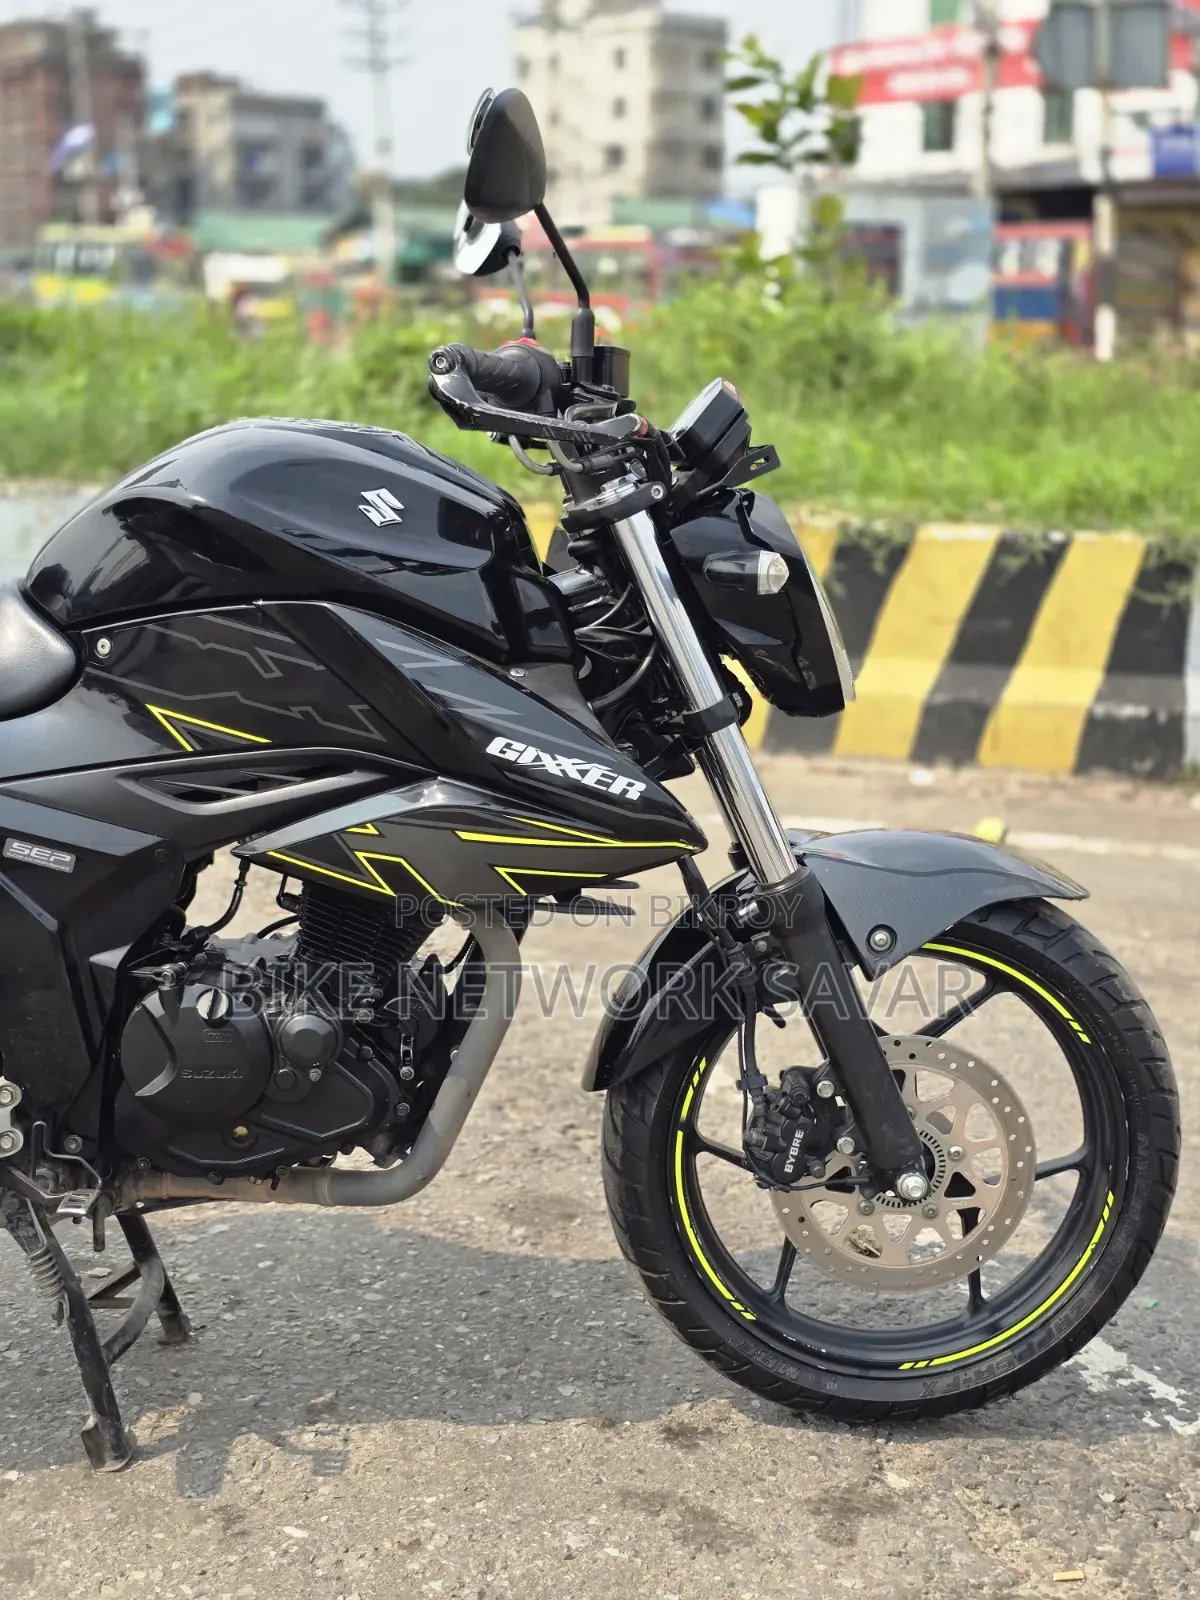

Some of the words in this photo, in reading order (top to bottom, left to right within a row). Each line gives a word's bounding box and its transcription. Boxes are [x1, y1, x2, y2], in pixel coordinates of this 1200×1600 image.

[486, 737, 646, 800] GIXXER
[9, 842, 72, 861] SEP
[181, 1069, 243, 1079] SUZUKI
[783, 1129, 805, 1173] BYBRE
